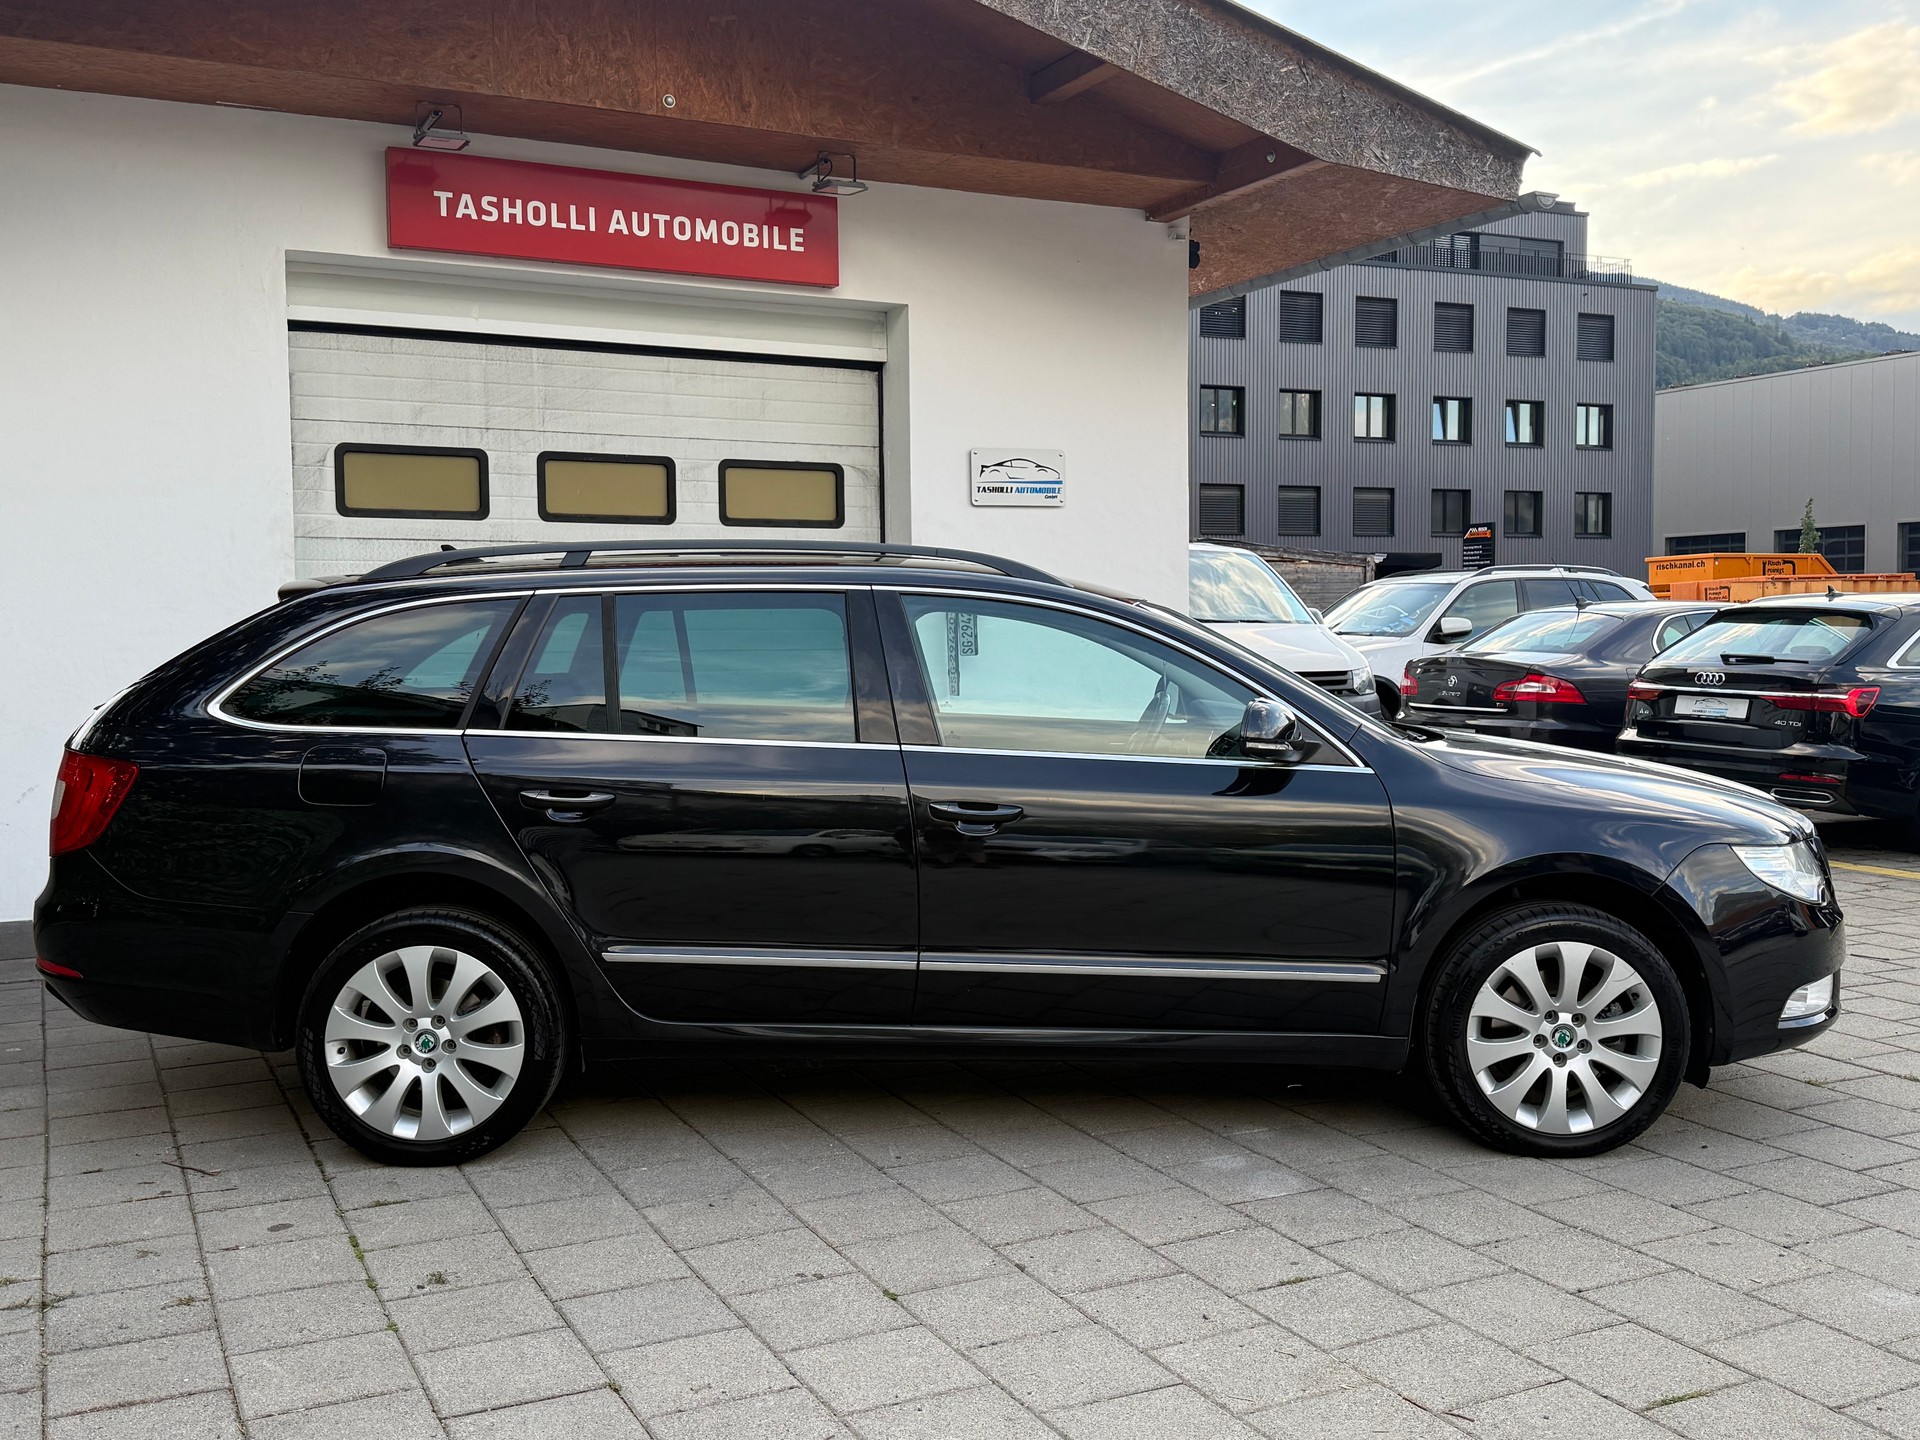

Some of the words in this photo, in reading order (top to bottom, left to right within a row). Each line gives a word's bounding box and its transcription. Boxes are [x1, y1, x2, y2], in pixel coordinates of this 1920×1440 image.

[433, 190, 596, 232] TASHOLLI
[608, 209, 805, 252] AUTOMOBILE
[1015, 486, 1062, 494] AUTOMOBILE
[1656, 560, 1706, 570] rischkanal.ch
